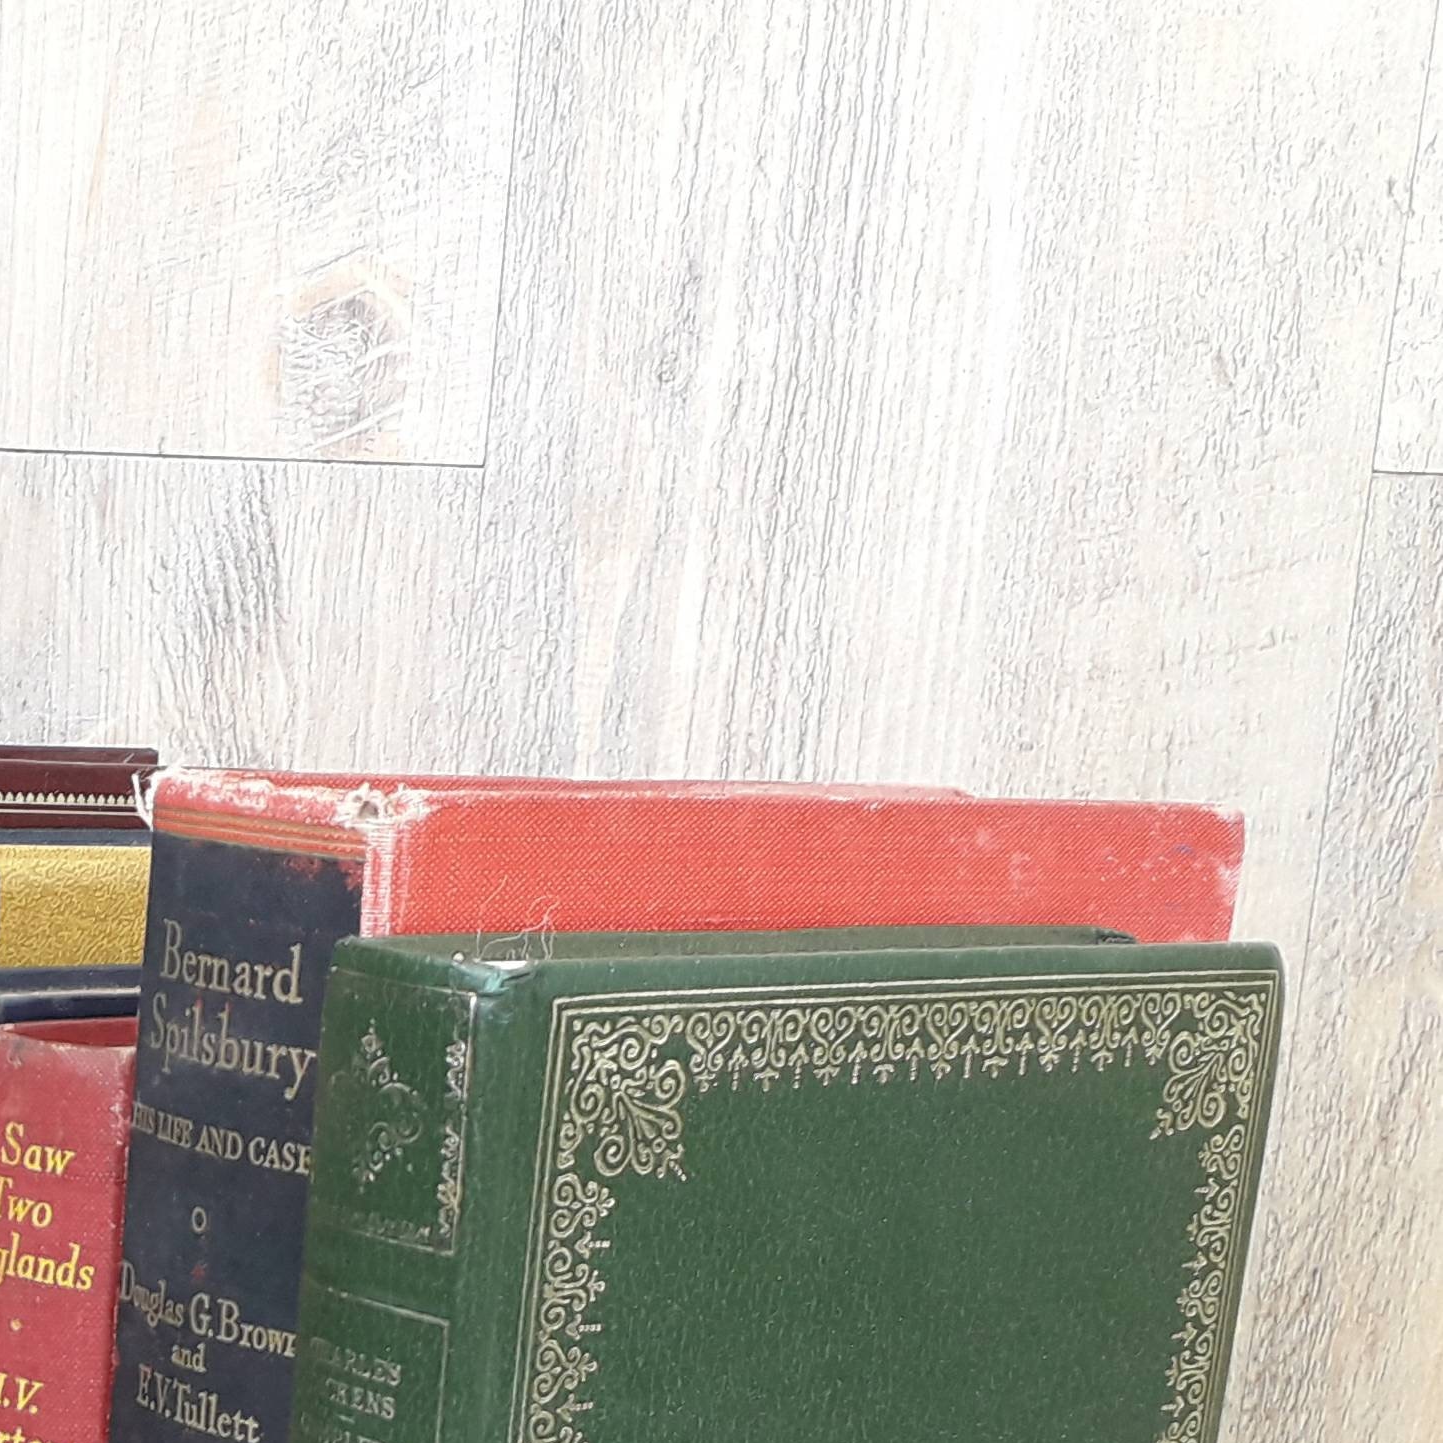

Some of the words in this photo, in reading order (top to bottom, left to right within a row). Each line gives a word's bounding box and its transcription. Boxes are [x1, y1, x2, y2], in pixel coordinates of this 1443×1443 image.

[160, 918, 303, 1004] Bernard
[151, 993, 316, 1100] Spilsbury
[1, 1122, 75, 1177] Saw
[132, 1100, 156, 1135] HIS
[157, 1111, 193, 1149] LIFE
[195, 1124, 243, 1160] AND
[248, 1136, 314, 1180] CASE
[120, 1260, 184, 1327] Douglas
[171, 1342, 207, 1373] and
